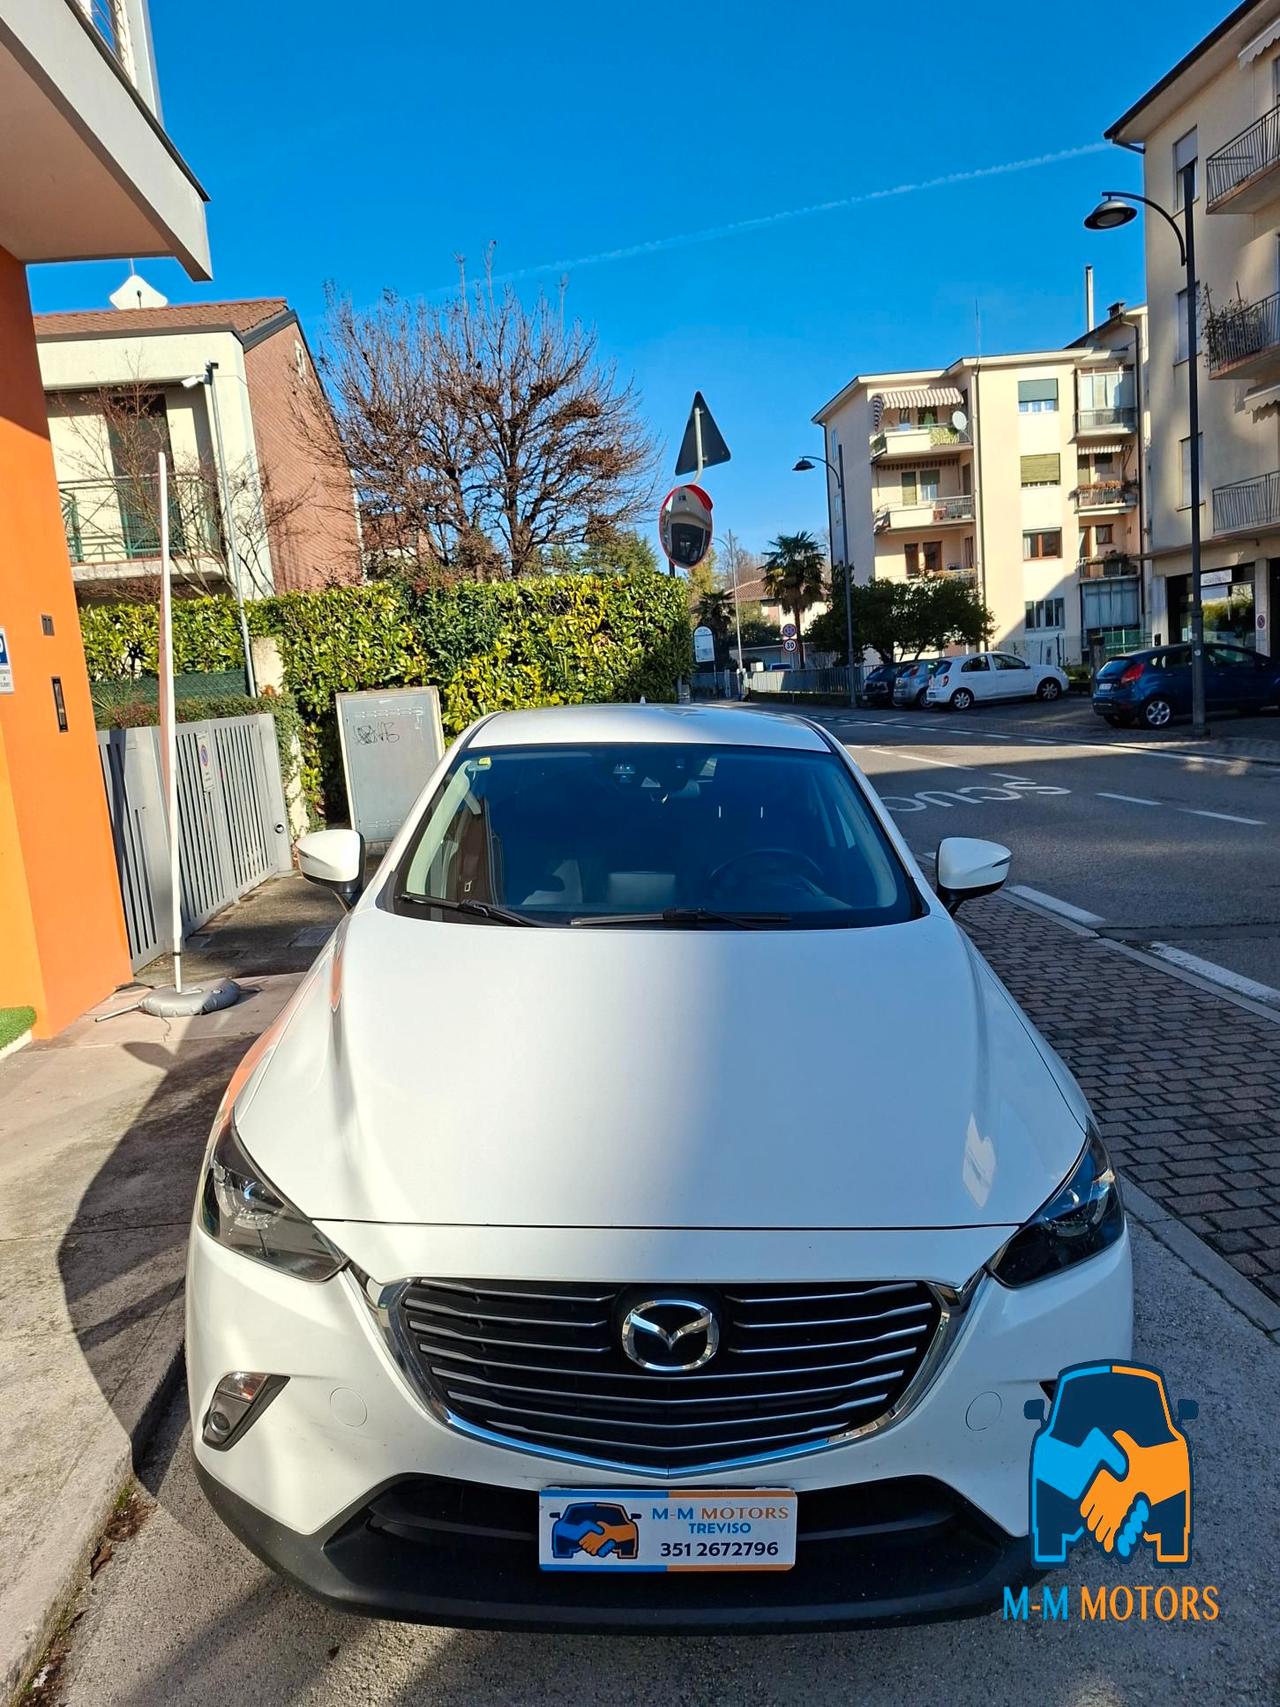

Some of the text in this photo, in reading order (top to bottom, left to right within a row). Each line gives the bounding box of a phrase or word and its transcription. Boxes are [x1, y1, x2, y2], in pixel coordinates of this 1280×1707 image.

[878, 780, 1073, 812] SCUO
[652, 1506, 789, 1520] M-M MOTORS
[688, 1522, 752, 1534] TREVISO
[660, 1541, 779, 1557] 351 2672796
